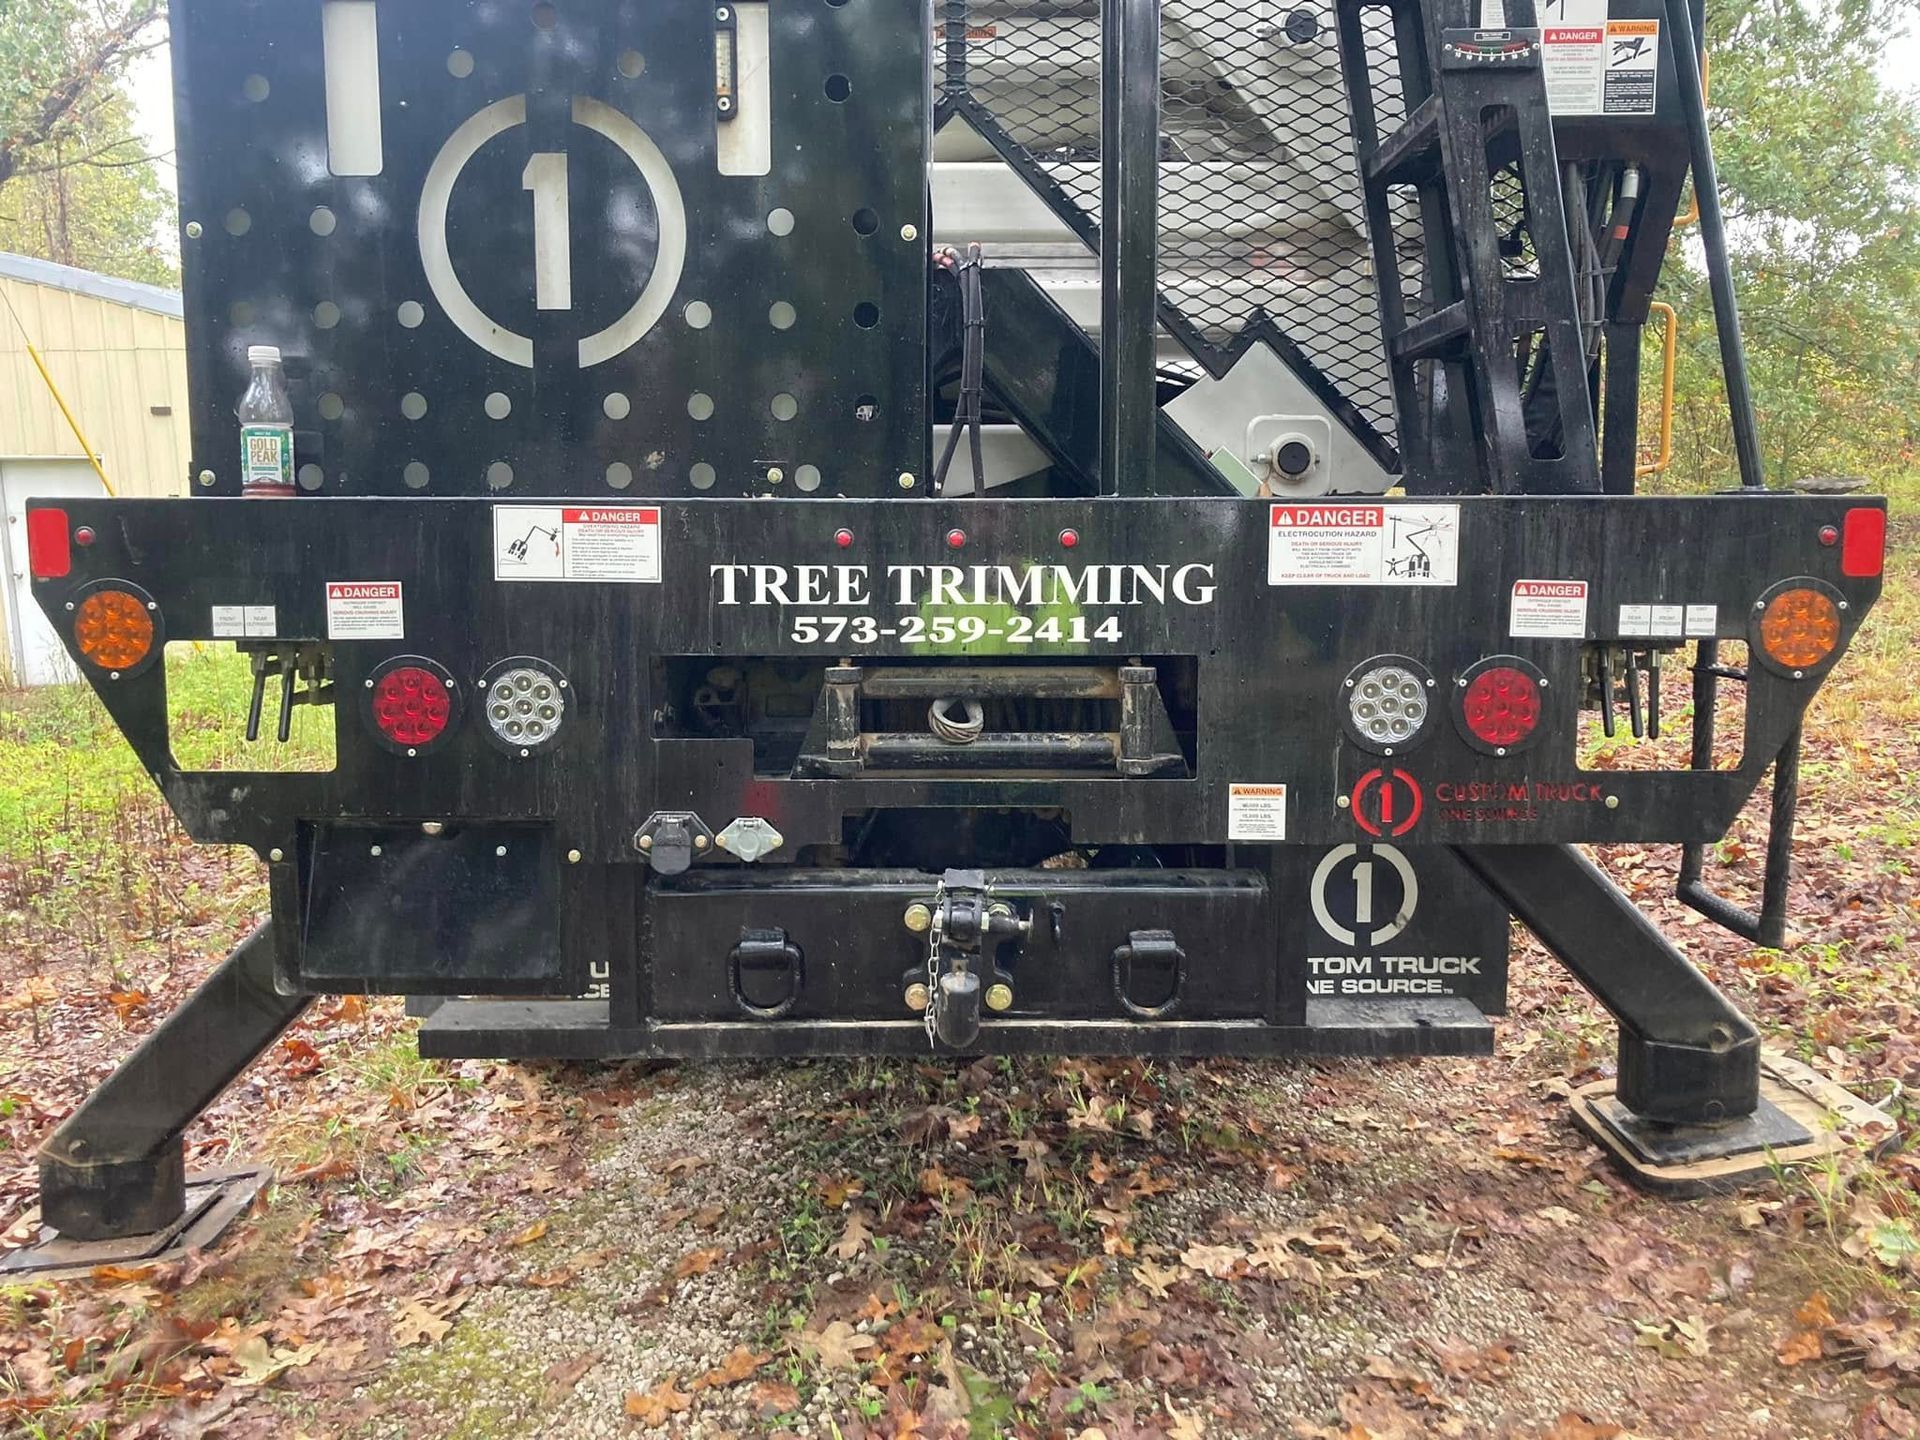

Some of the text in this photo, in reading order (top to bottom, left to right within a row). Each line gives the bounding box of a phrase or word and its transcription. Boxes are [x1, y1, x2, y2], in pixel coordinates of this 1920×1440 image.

[1559, 32, 1597, 40] DANGER
[522, 152, 571, 310] 1
[250, 438, 277, 450] GOLD
[251, 451, 277, 463] PEAK
[592, 512, 641, 522] DANGER
[1296, 510, 1378, 525] DANGER
[709, 563, 1218, 605] TREE TRIMMING
[1530, 585, 1581, 596] DANGER
[344, 587, 396, 597] DANGER
[790, 616, 1123, 644] 573-259-2414
[1536, 783, 1603, 802] TRUCK
[1379, 782, 1392, 823] 1
[1352, 861, 1372, 923] 1
[1307, 957, 1482, 974] TOM TRUCK
[1306, 979, 1335, 994] NE
[1341, 979, 1443, 994] SOURCE
